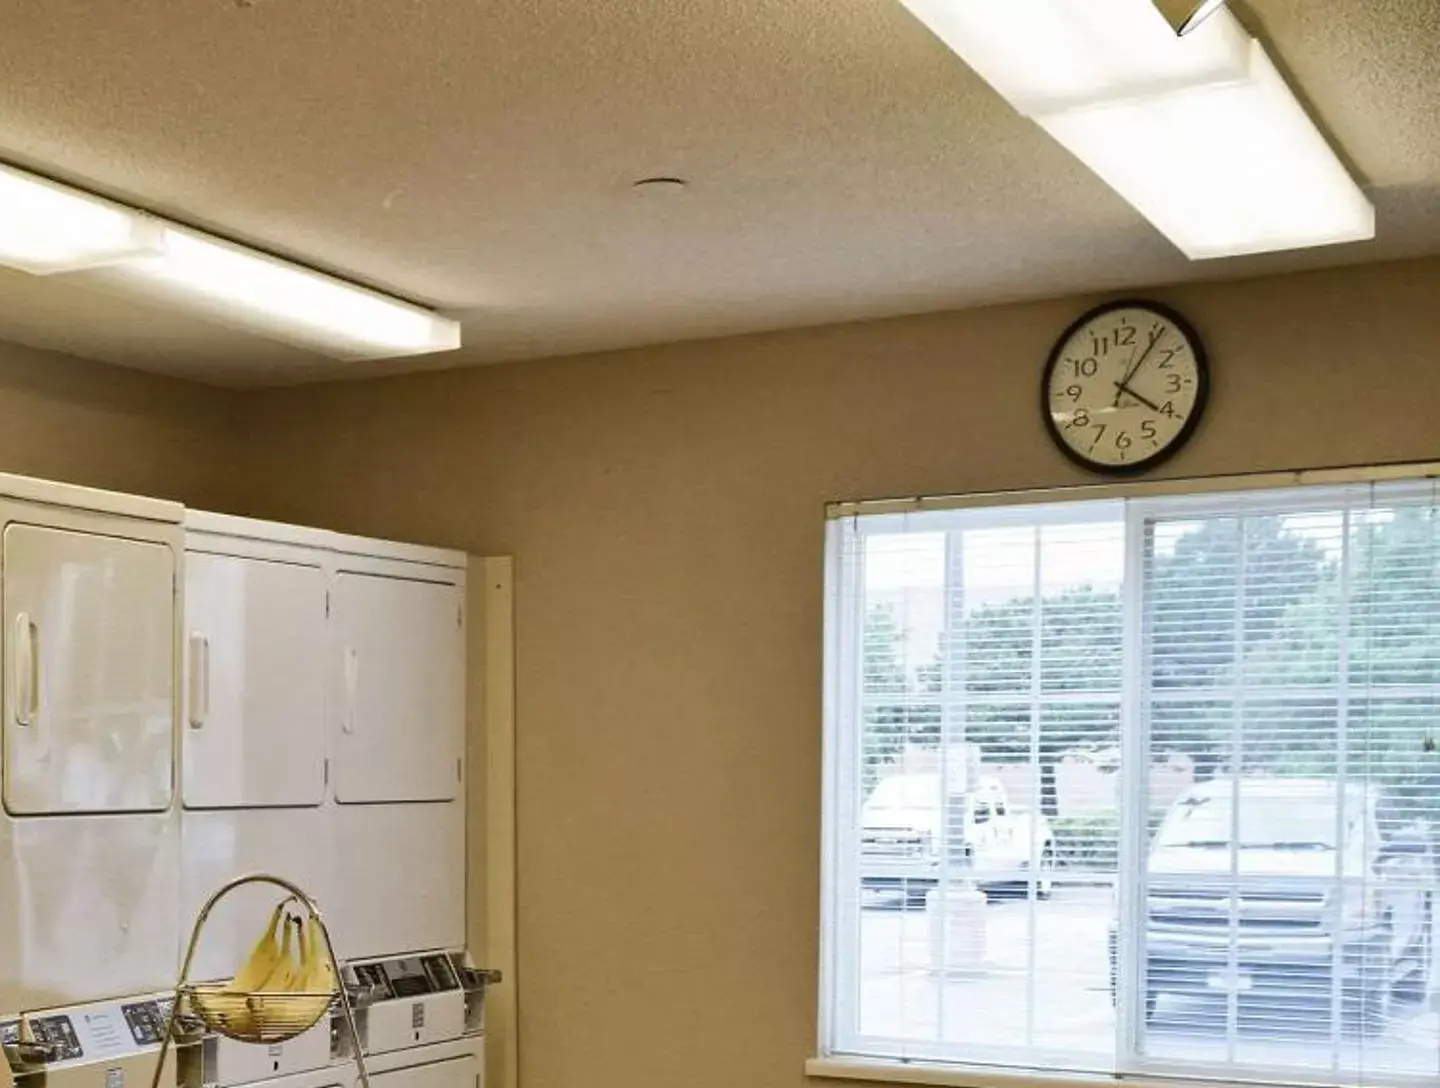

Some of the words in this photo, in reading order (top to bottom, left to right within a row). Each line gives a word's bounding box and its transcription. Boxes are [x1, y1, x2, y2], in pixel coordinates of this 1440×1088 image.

[1113, 325, 1137, 346] 12
[1093, 337, 1108, 357] 11
[1074, 357, 1098, 377] 10
[1158, 349, 1176, 370] 2
[1066, 384, 1082, 402] 9
[1165, 374, 1182, 394] 3
[1072, 408, 1090, 428] 8
[1160, 400, 1175, 419] 4
[1091, 423, 1107, 444] 7
[1141, 420, 1157, 439] 5
[1115, 431, 1132, 450] 6
